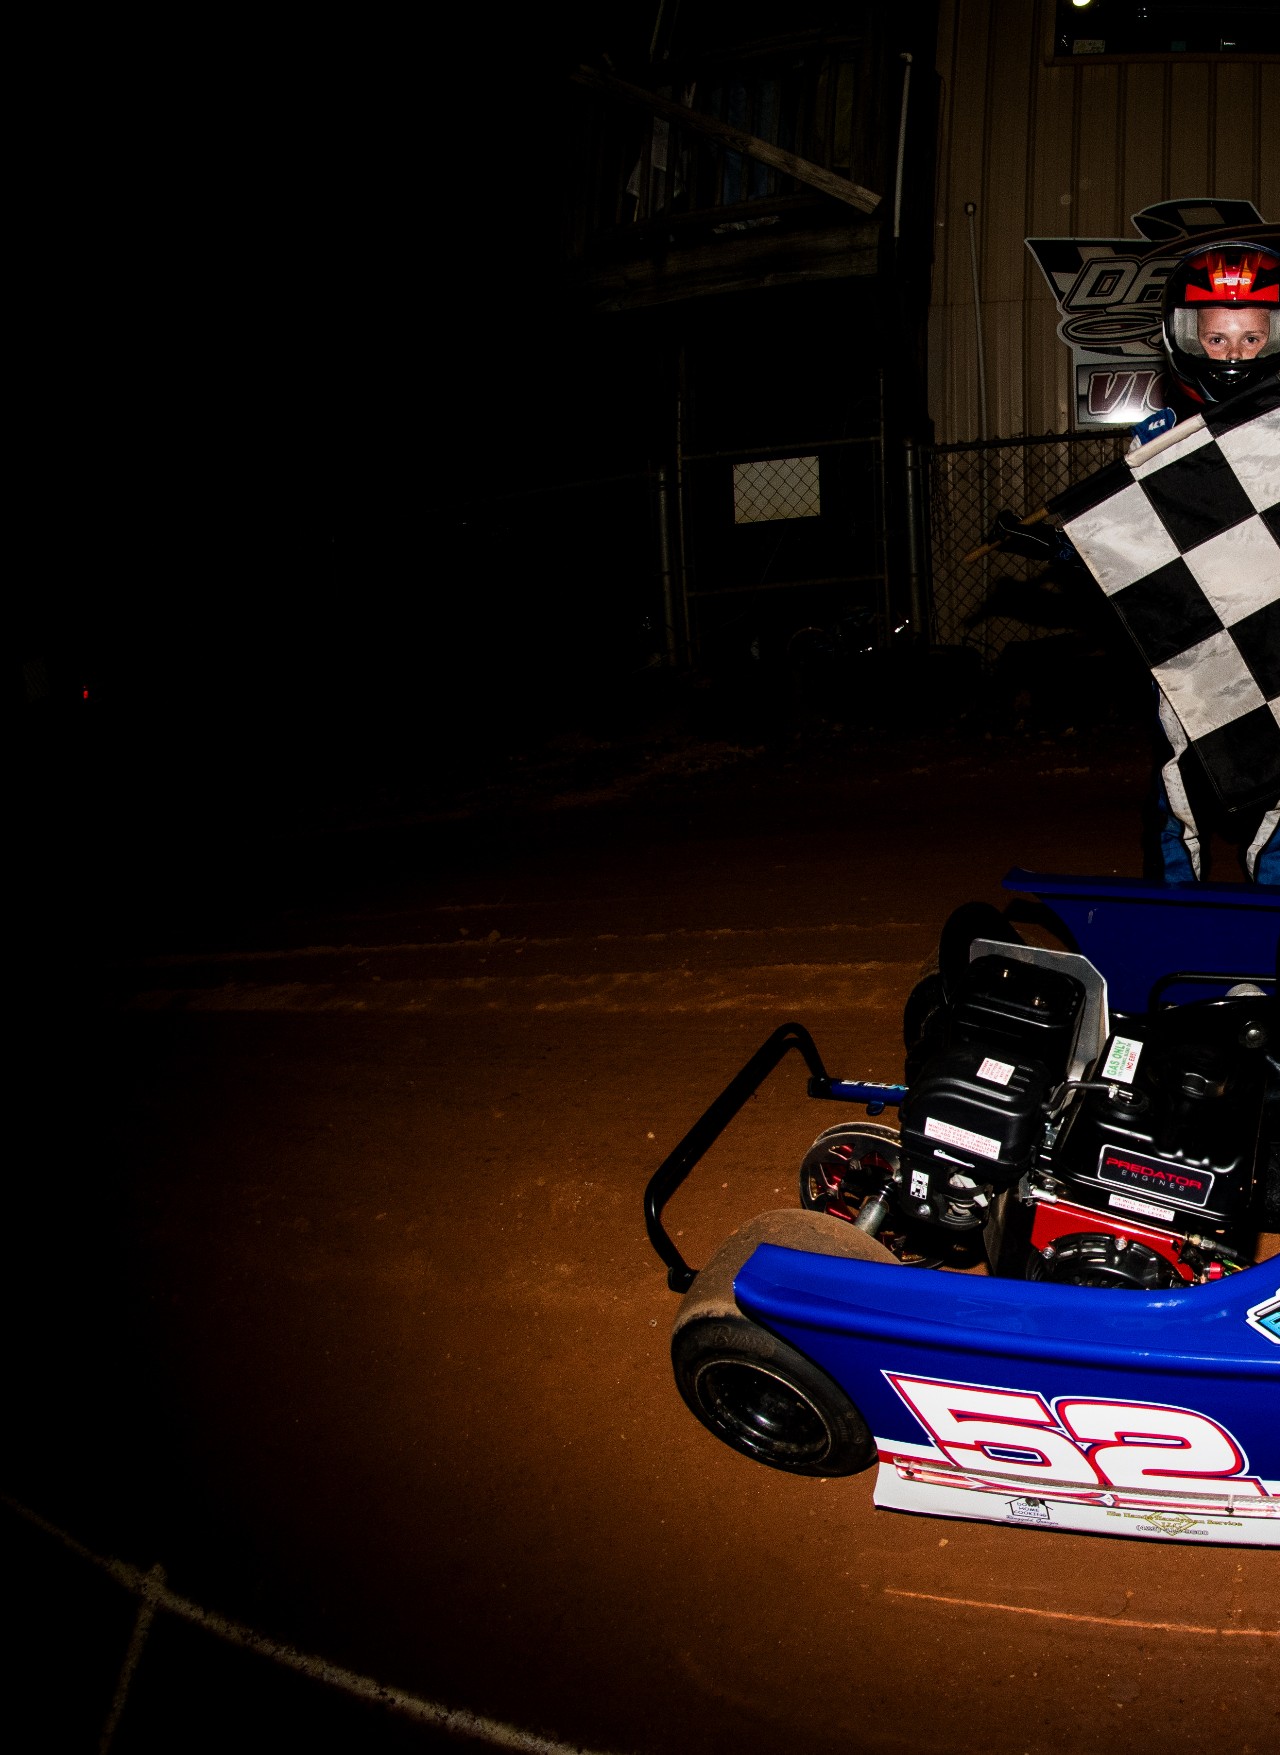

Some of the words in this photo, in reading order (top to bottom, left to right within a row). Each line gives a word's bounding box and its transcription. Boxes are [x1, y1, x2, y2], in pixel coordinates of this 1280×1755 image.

[1112, 1040, 1126, 1060] ONLY
[1106, 1059, 1120, 1076] GAS
[1105, 1157, 1202, 1190] PREDATOR
[1122, 1169, 1185, 1191] ENGINES
[881, 1370, 1250, 1486] 52
